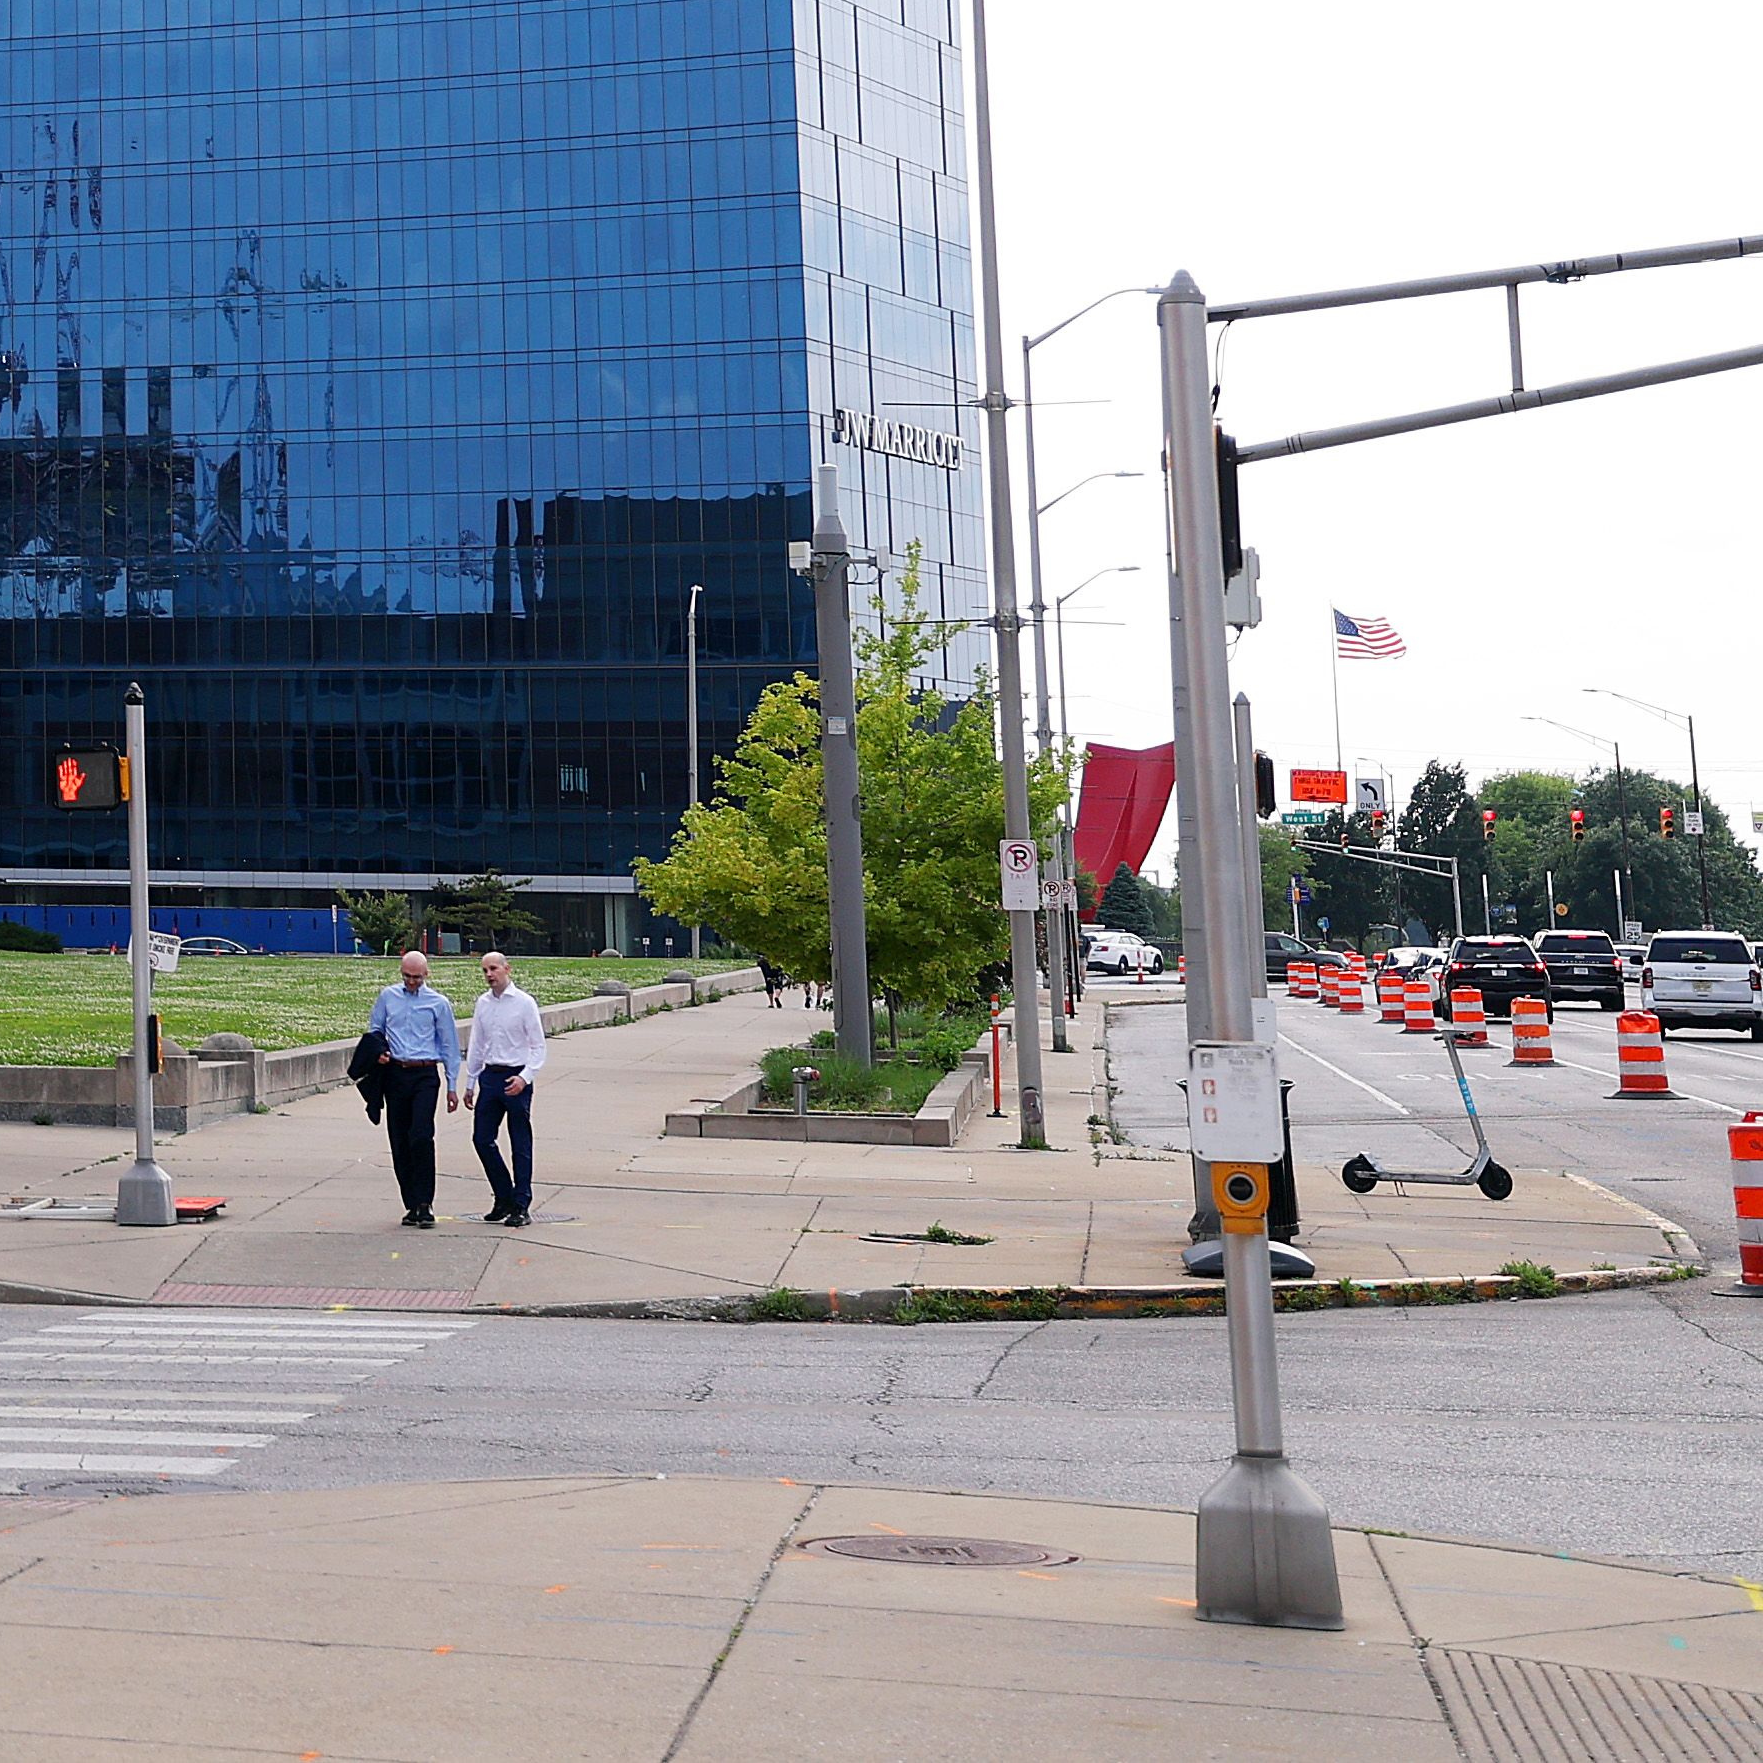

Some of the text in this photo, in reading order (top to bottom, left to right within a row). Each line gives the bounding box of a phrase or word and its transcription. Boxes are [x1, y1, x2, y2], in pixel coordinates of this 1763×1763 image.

[841, 408, 966, 471] JW MARRIOTT
[1359, 802, 1381, 810] ONLY
[1284, 815, 1322, 823] West St
[1626, 932, 1641, 940] 25
